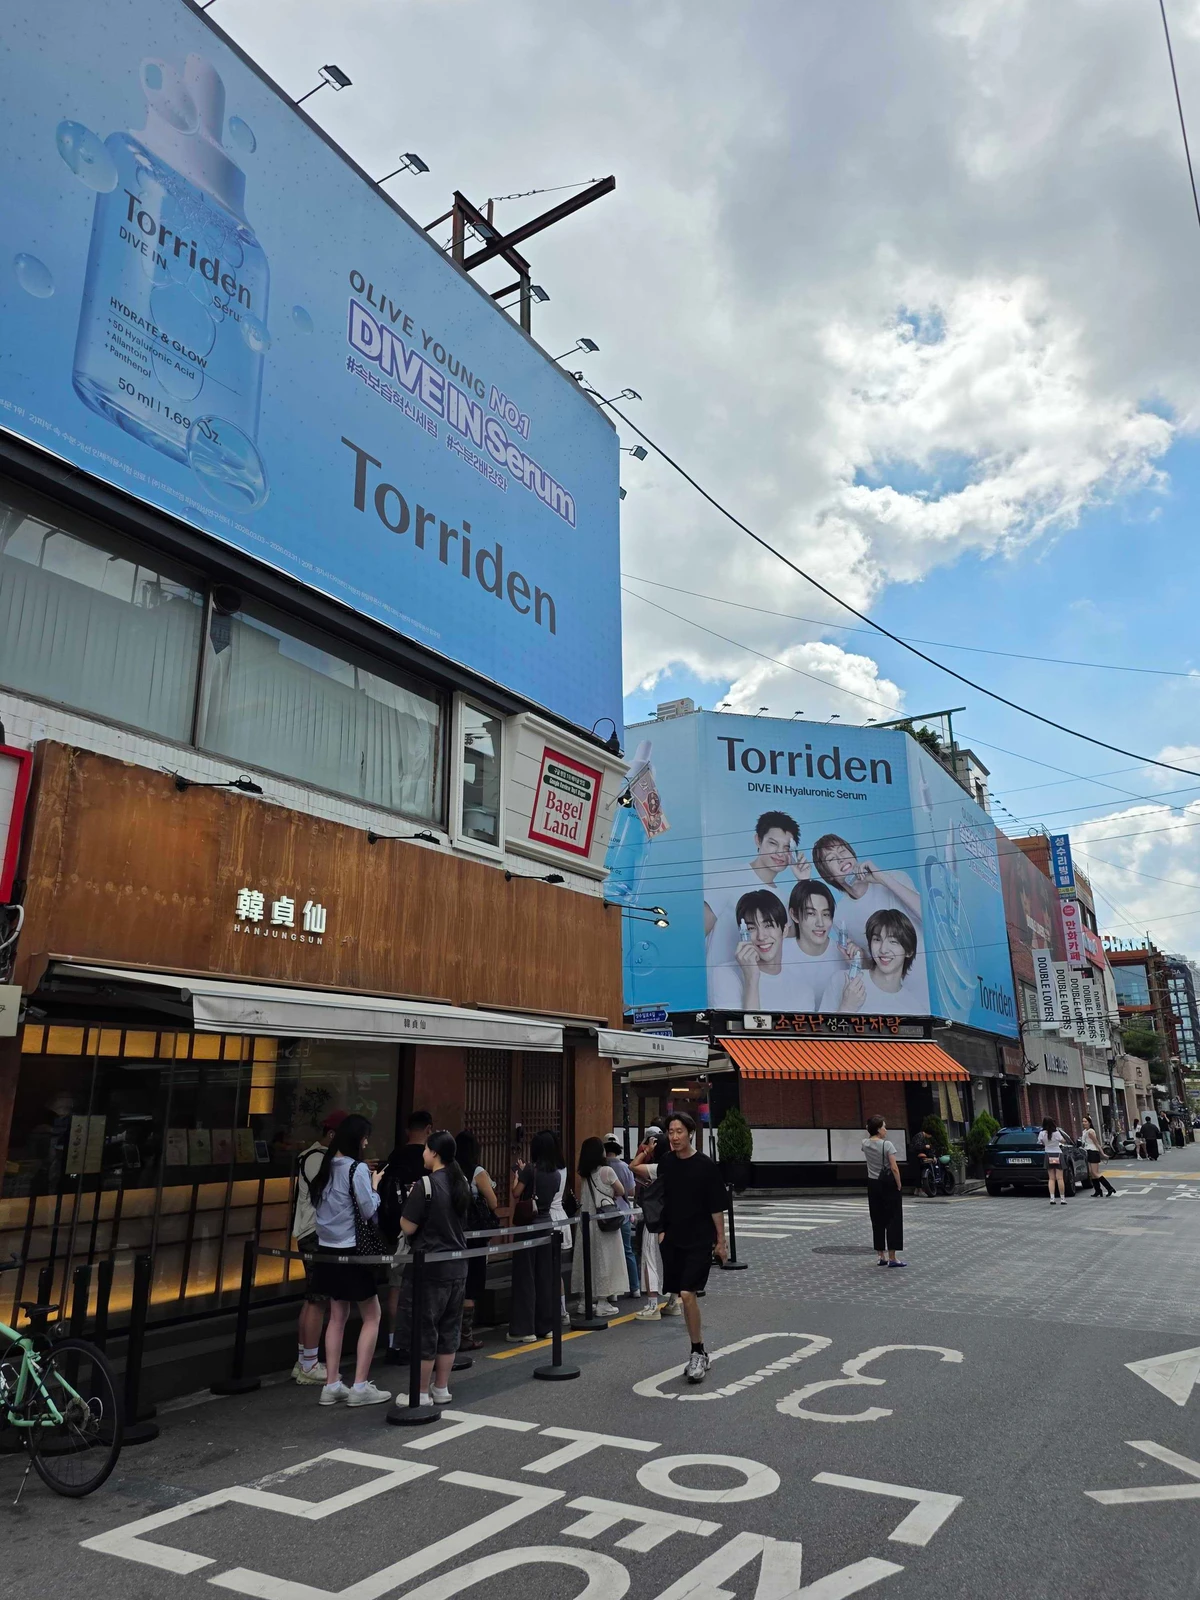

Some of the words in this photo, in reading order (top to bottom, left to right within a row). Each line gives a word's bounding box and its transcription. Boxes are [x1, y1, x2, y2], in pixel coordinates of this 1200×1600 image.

[119, 225, 148, 257] DIVE
[152, 250, 167, 270] IN
[124, 189, 251, 309] Torriden
[213, 295, 242, 323] Seru
[110, 296, 159, 338] HYDRATE
[161, 333, 169, 343] &
[172, 340, 208, 368] GLOW
[111, 333, 148, 363] Allantoin
[349, 269, 414, 337] OLIVE
[421, 328, 486, 400] YOUNG
[110, 346, 151, 378] Panthenol
[125, 329, 173, 366] Hyaluronic
[174, 361, 195, 380] Acid
[118, 377, 136, 396] 50
[137, 391, 154, 409] ml
[164, 406, 191, 429] 1.69
[348, 298, 446, 419] DIVE
[446, 381, 484, 451] IN
[484, 417, 577, 529] Serum
[446, 433, 508, 493] #수분2배강화
[341, 436, 556, 636] Torriden
[716, 735, 893, 785] Torriden
[545, 789, 583, 820] Bagel
[747, 782, 772, 794] DIVE
[773, 784, 783, 794] IN
[784, 785, 835, 799] Hyaluronic
[836, 789, 868, 801] Serum
[543, 811, 578, 840] Land
[235, 887, 327, 934] 韓貞仙
[233, 923, 323, 945] HANJUNGSUN
[1065, 920, 1081, 961] 만화카페
[1037, 957, 1051, 988] DOUBLE
[1056, 969, 1068, 999] DOUBLE
[977, 975, 1014, 1018] Torriden
[1043, 991, 1055, 1023] LOVERS
[1070, 978, 1081, 1007] DOUBLE
[1082, 984, 1093, 1011] DOUBLE
[775, 1014, 825, 1032] 소문난
[827, 1018, 849, 1032] 성수
[851, 1016, 901, 1034] 감자탕
[1060, 1000, 1072, 1030] LOVERS
